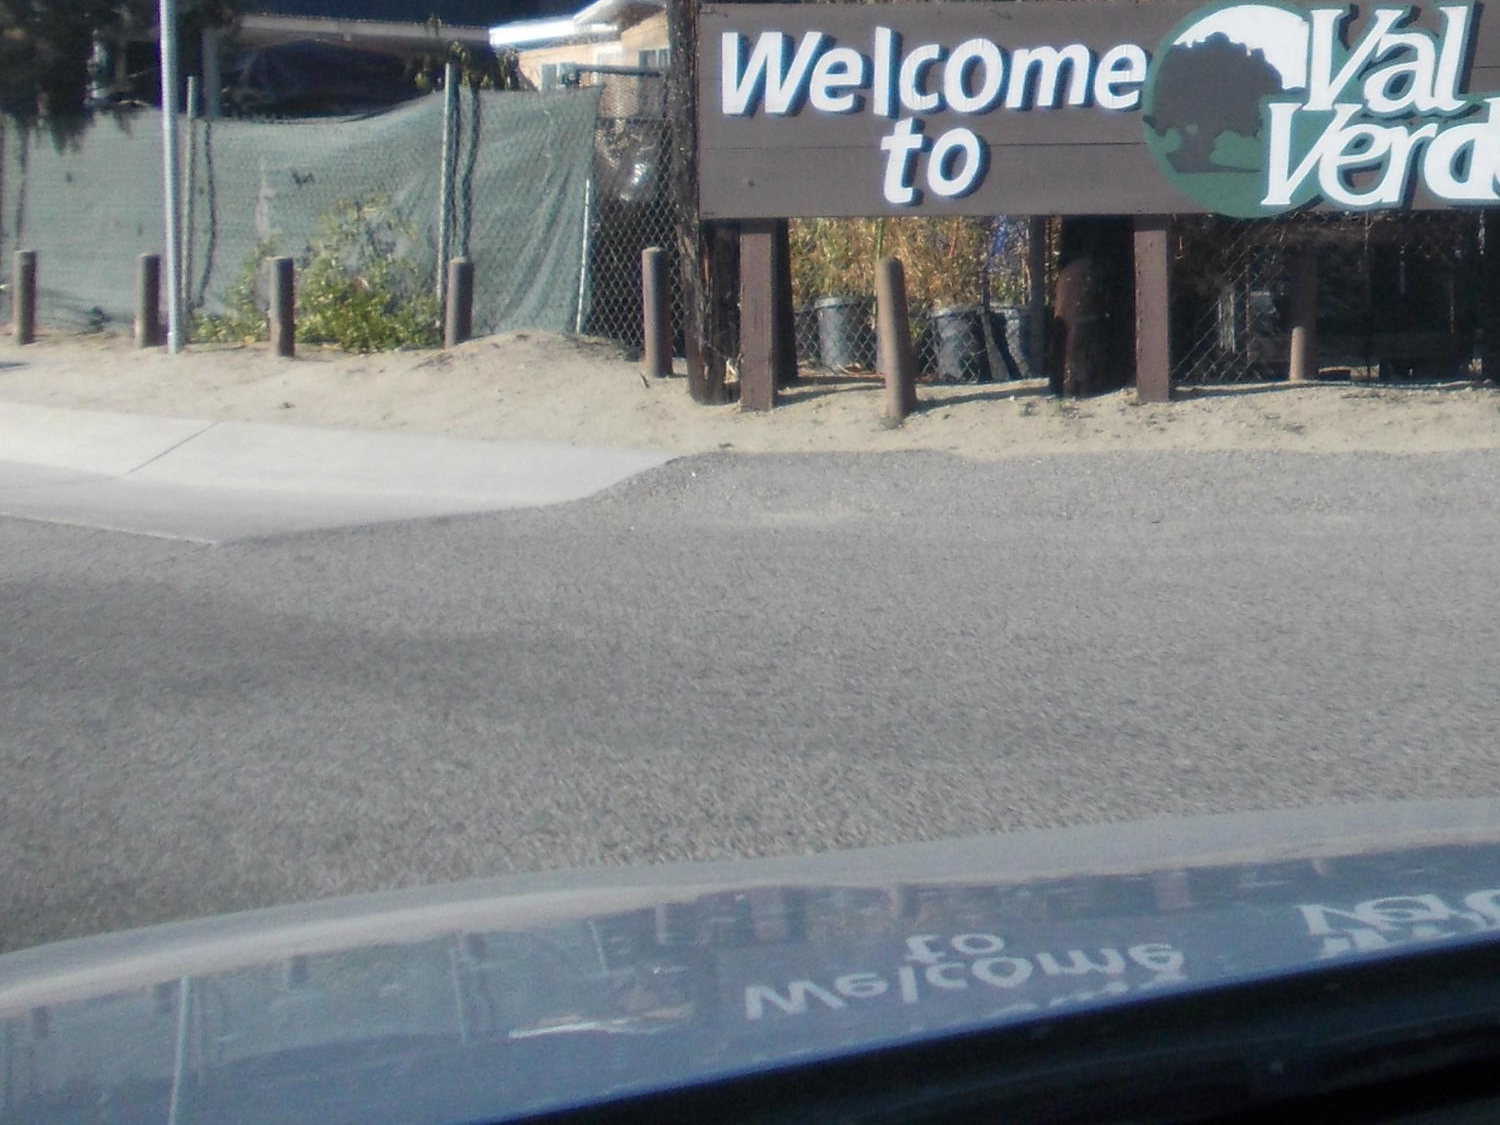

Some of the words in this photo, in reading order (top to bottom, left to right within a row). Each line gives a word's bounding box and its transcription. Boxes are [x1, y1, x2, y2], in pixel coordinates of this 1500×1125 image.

[721, 25, 1149, 117] Welcome
[1301, 5, 1467, 114] Val
[880, 116, 982, 205] to
